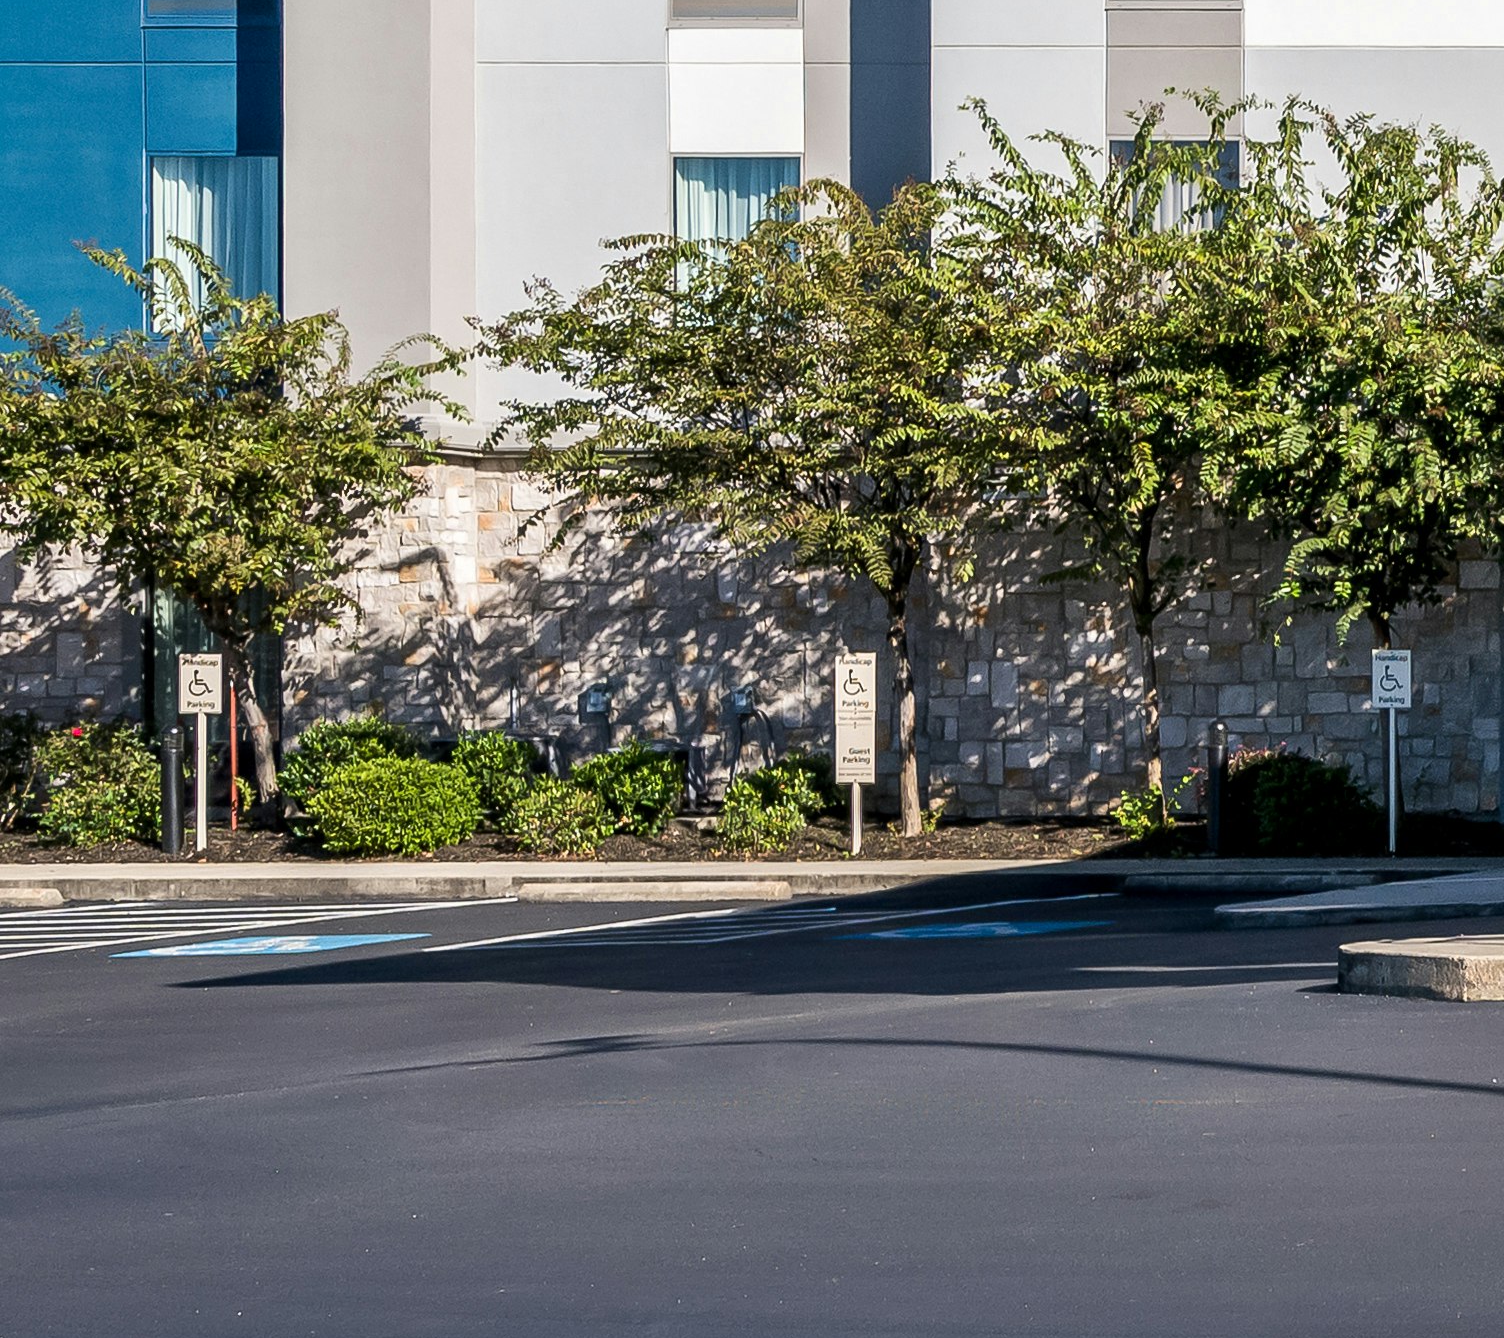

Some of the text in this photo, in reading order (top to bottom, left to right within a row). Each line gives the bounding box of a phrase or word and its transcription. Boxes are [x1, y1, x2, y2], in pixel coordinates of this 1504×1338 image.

[1378, 696, 1405, 704] Parking
[187, 701, 215, 709] Parking
[842, 700, 869, 709] Parking
[842, 756, 871, 765] Parking
